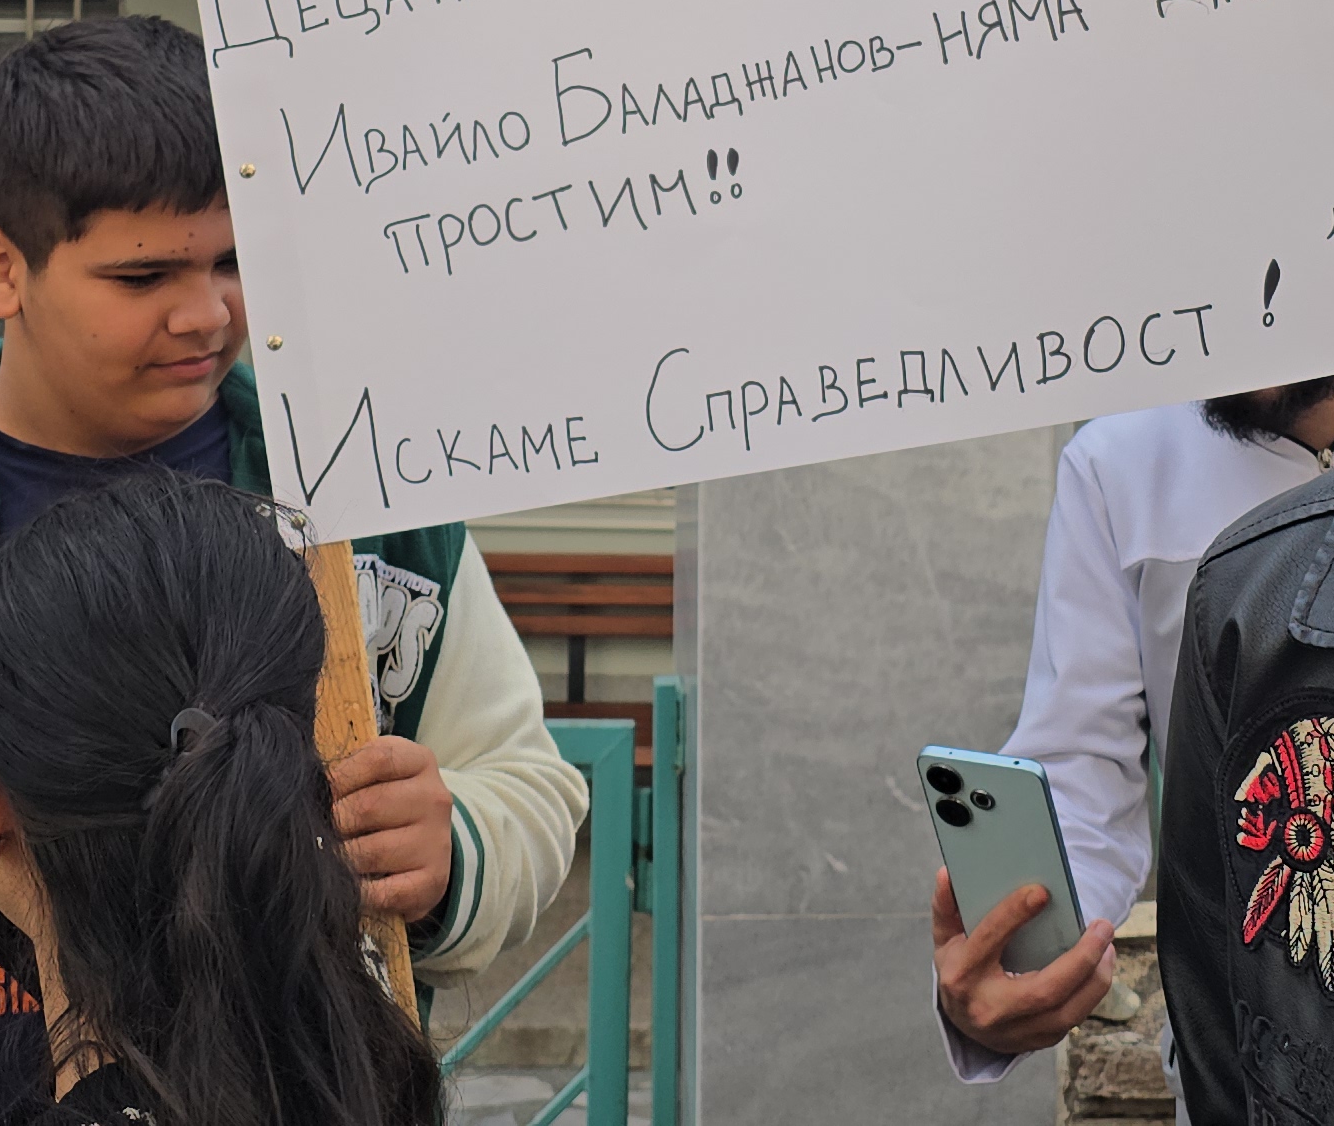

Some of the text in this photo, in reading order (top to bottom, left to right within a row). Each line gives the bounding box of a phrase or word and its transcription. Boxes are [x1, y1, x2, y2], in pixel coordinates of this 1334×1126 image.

[280, 103, 531, 195] ИВАЙЛО
[383, 146, 744, 276] ПРОСТИМ!!
[280, 385, 599, 510] ИСКАМЕ
